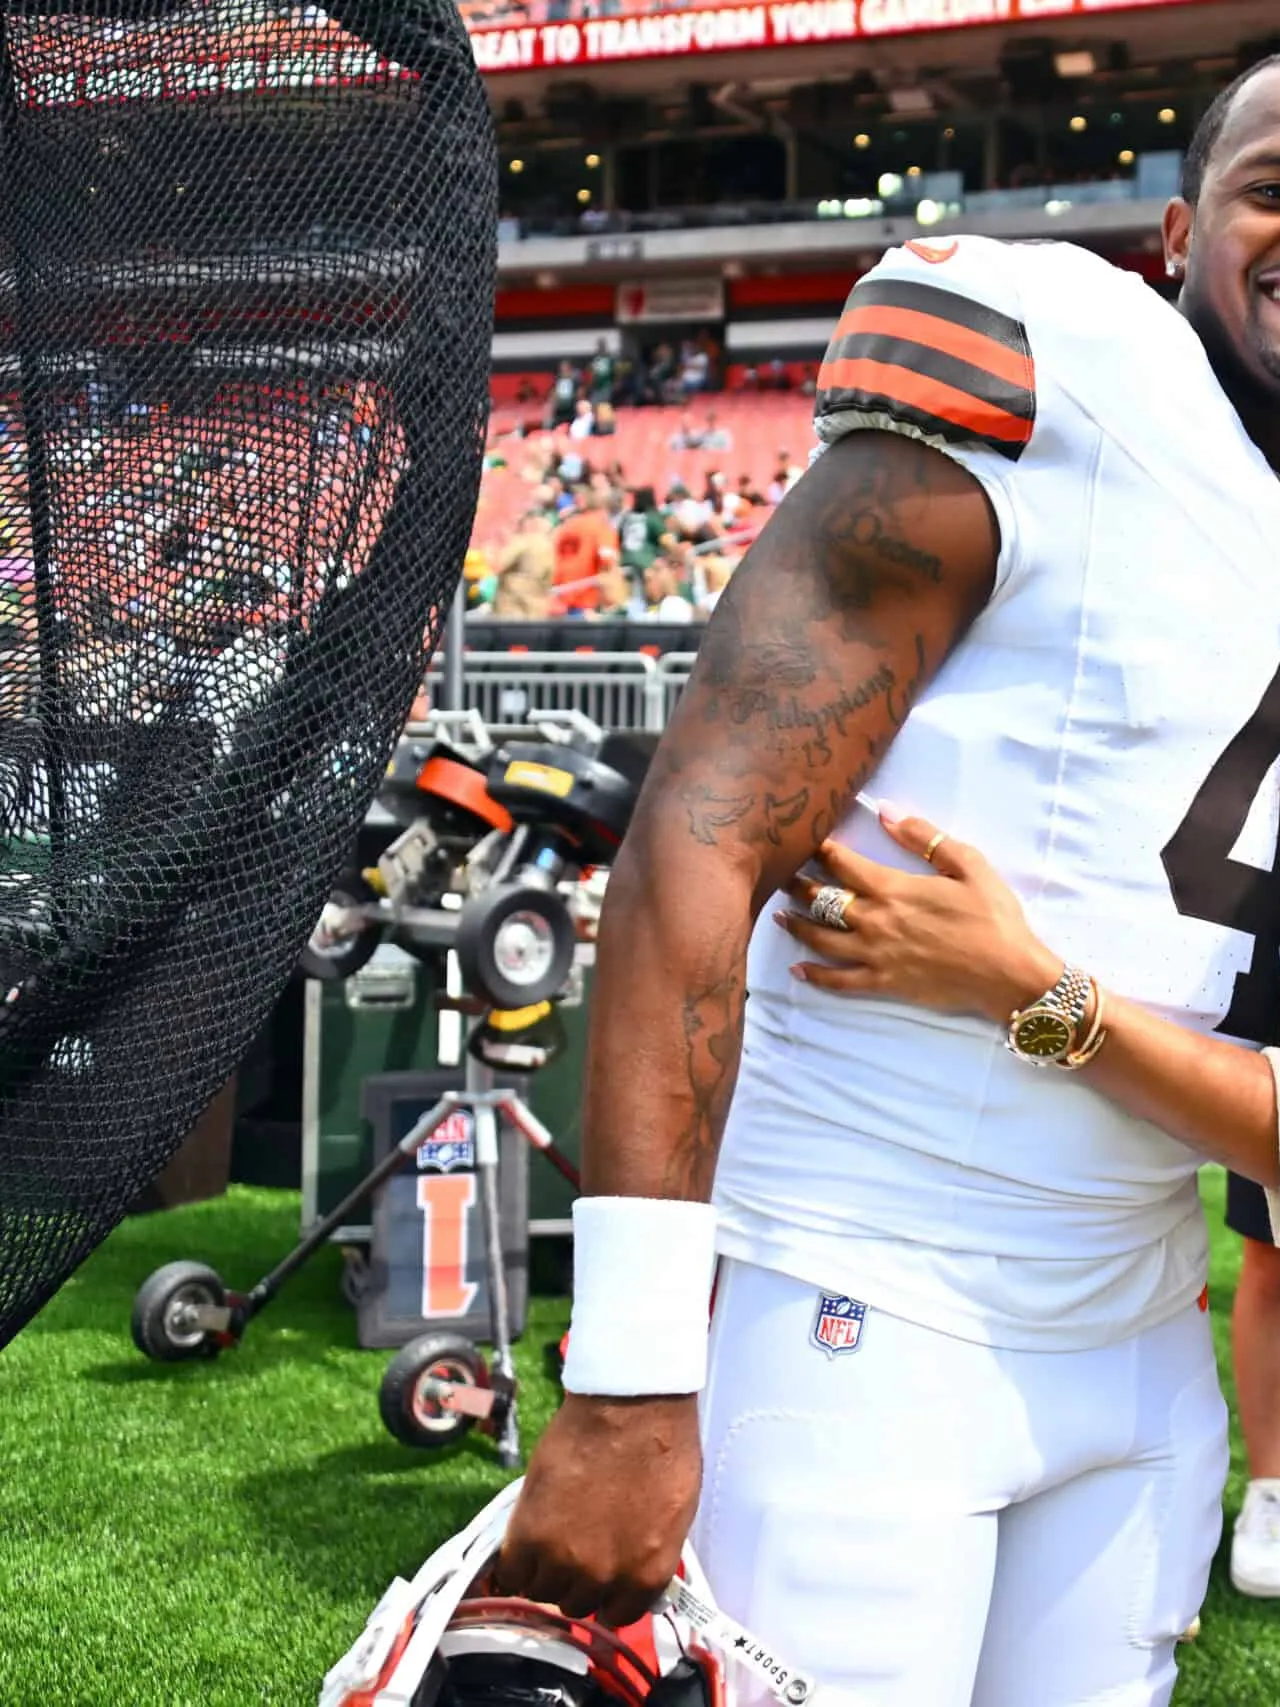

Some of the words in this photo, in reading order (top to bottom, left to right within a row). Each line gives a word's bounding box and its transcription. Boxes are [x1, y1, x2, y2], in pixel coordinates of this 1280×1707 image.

[543, 25, 579, 61] TO
[586, 8, 764, 56] TRANSFORM
[771, 0, 856, 38] YOUR
[819, 1316, 857, 1346] NFL
[746, 1643, 789, 1686] SPORT
